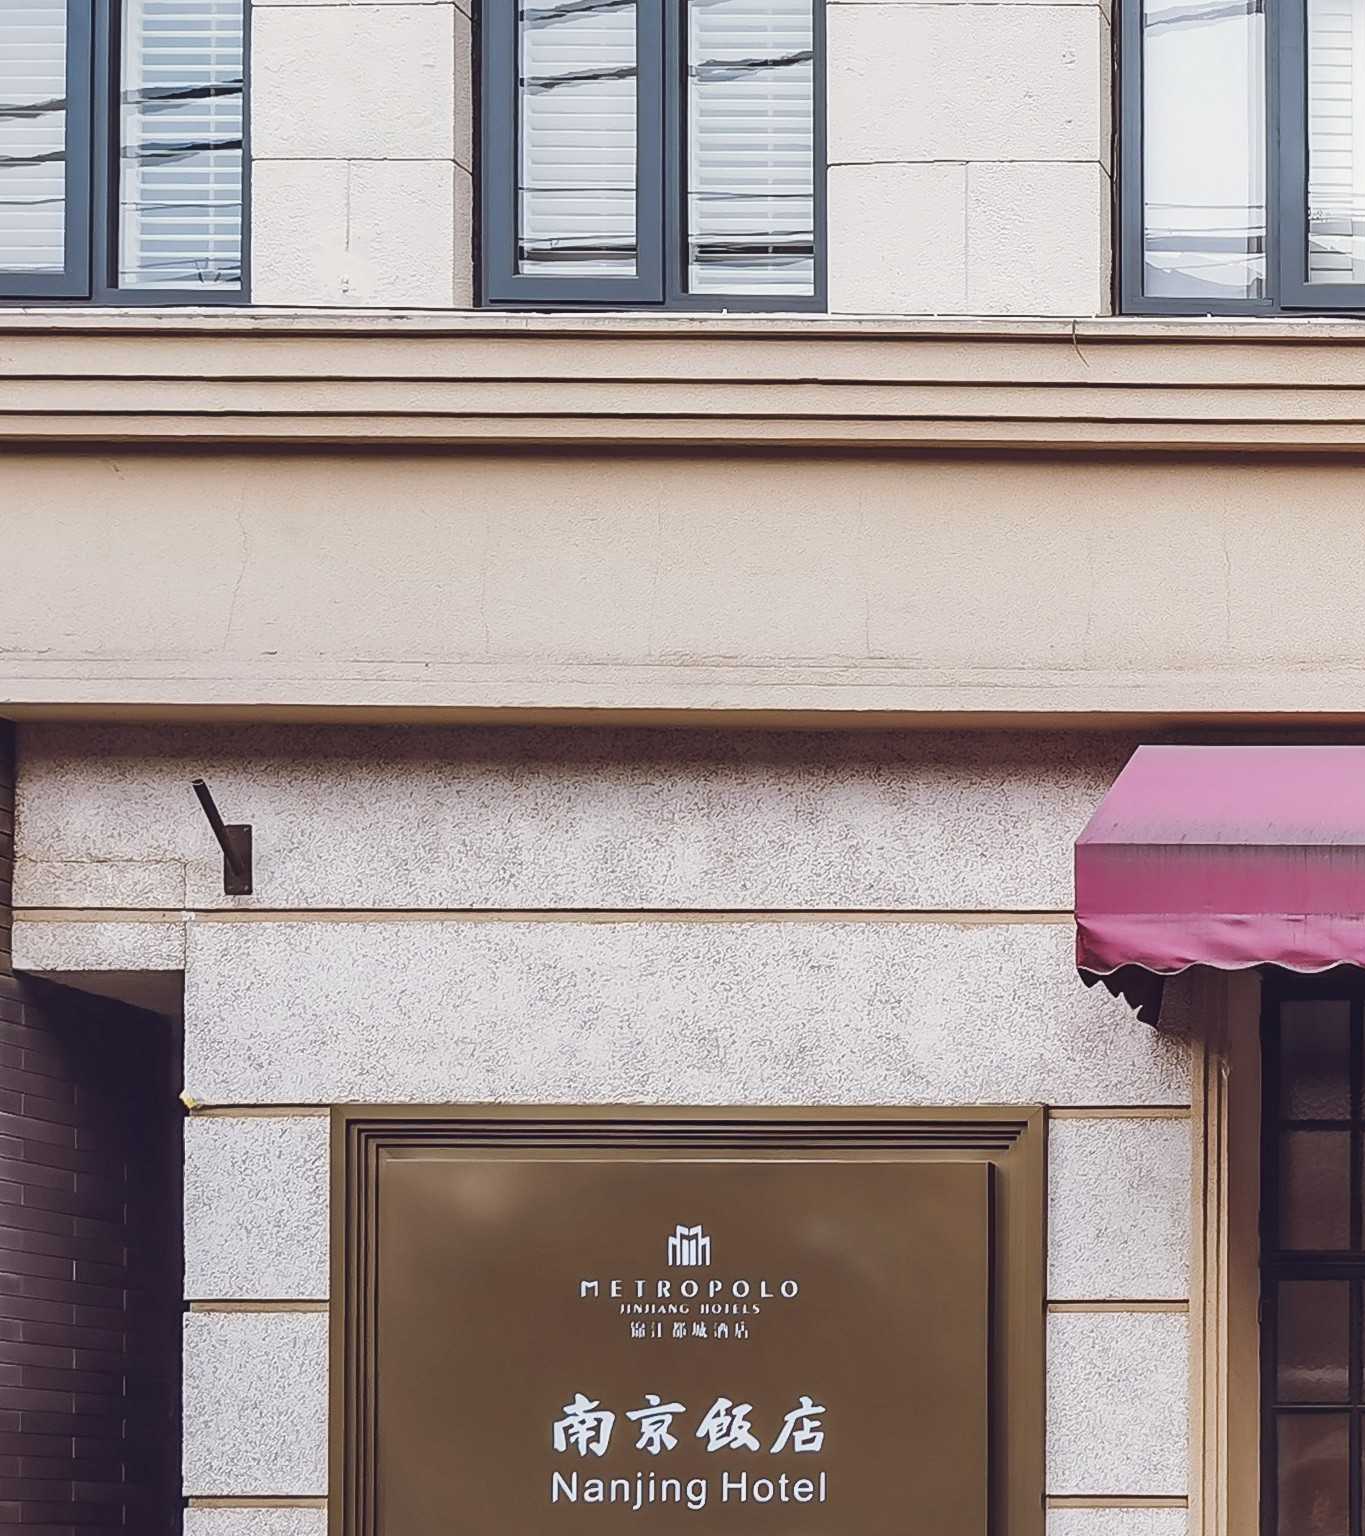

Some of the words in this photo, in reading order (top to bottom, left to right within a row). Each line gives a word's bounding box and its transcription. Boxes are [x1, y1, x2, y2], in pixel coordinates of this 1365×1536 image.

[579, 1279, 800, 1299] METROPOLO
[619, 1303, 690, 1315] JINJIANG
[699, 1303, 761, 1315] HOTELS
[551, 1392, 828, 1457] 南京飯店
[551, 1470, 709, 1511] Nanjing
[721, 1470, 828, 1504] Hotel
